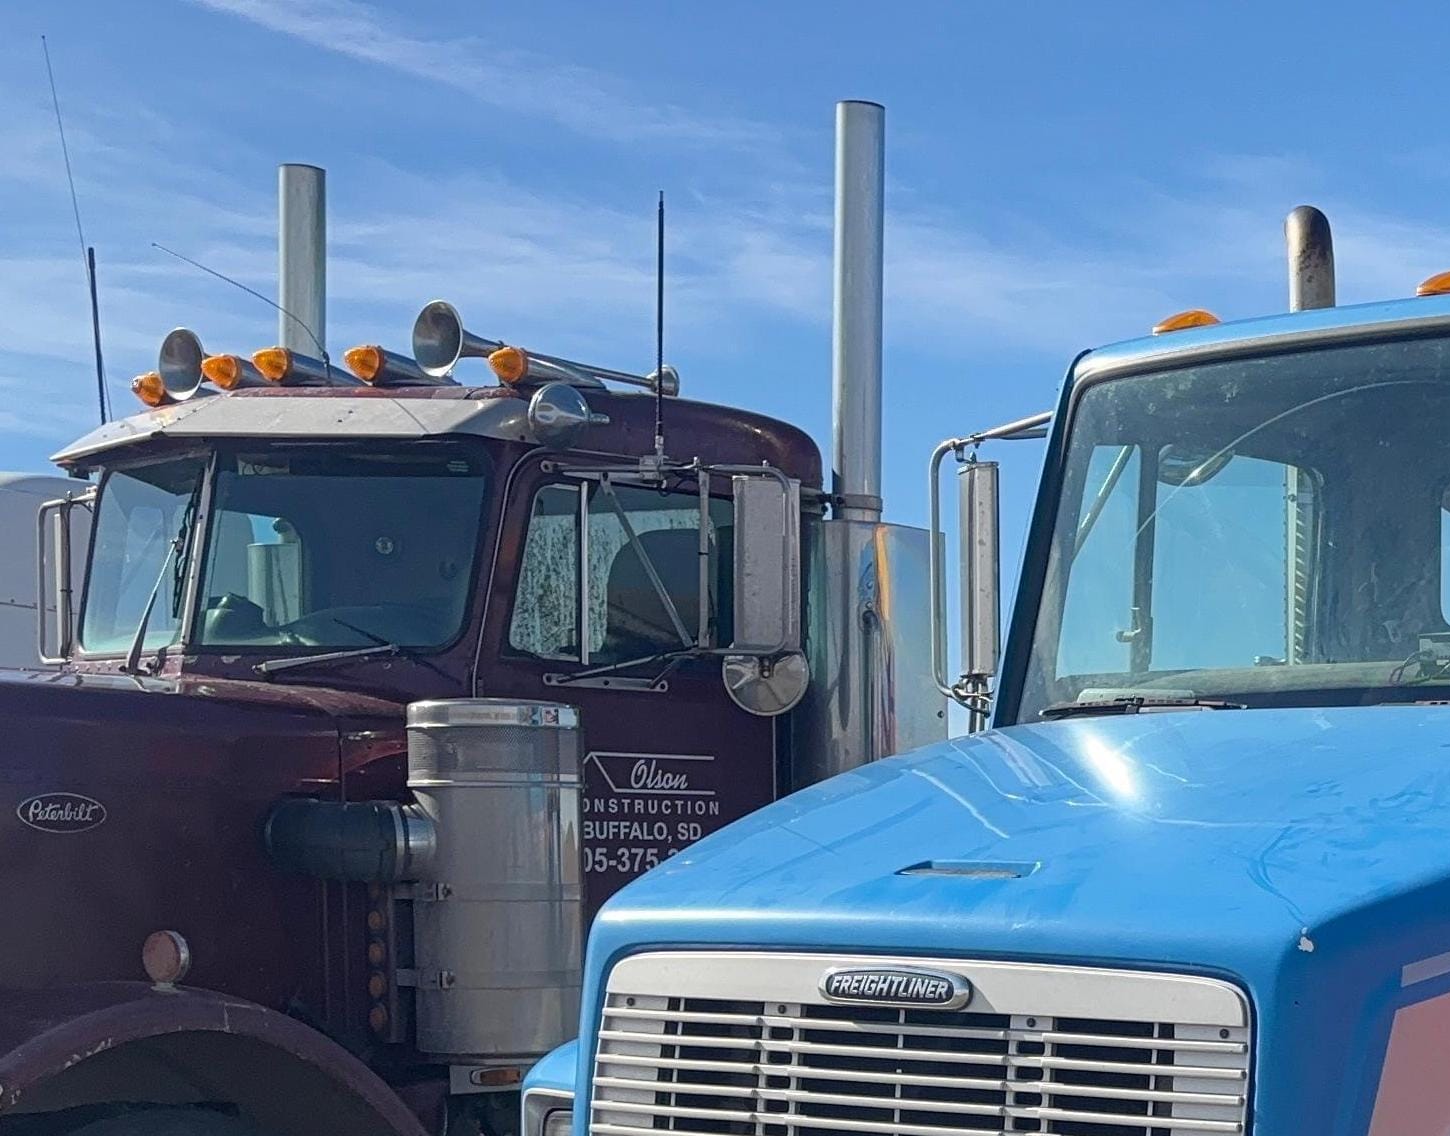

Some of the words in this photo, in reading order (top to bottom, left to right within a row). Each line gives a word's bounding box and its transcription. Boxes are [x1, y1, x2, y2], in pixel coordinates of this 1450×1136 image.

[630, 759, 689, 790] Olson
[28, 799, 99, 822] Peterbilt
[583, 798, 720, 816] ONSTRUCTION
[583, 821, 673, 843] BUFFALO,
[677, 822, 702, 841] SD
[831, 975, 949, 999] FREIGHTLINER
